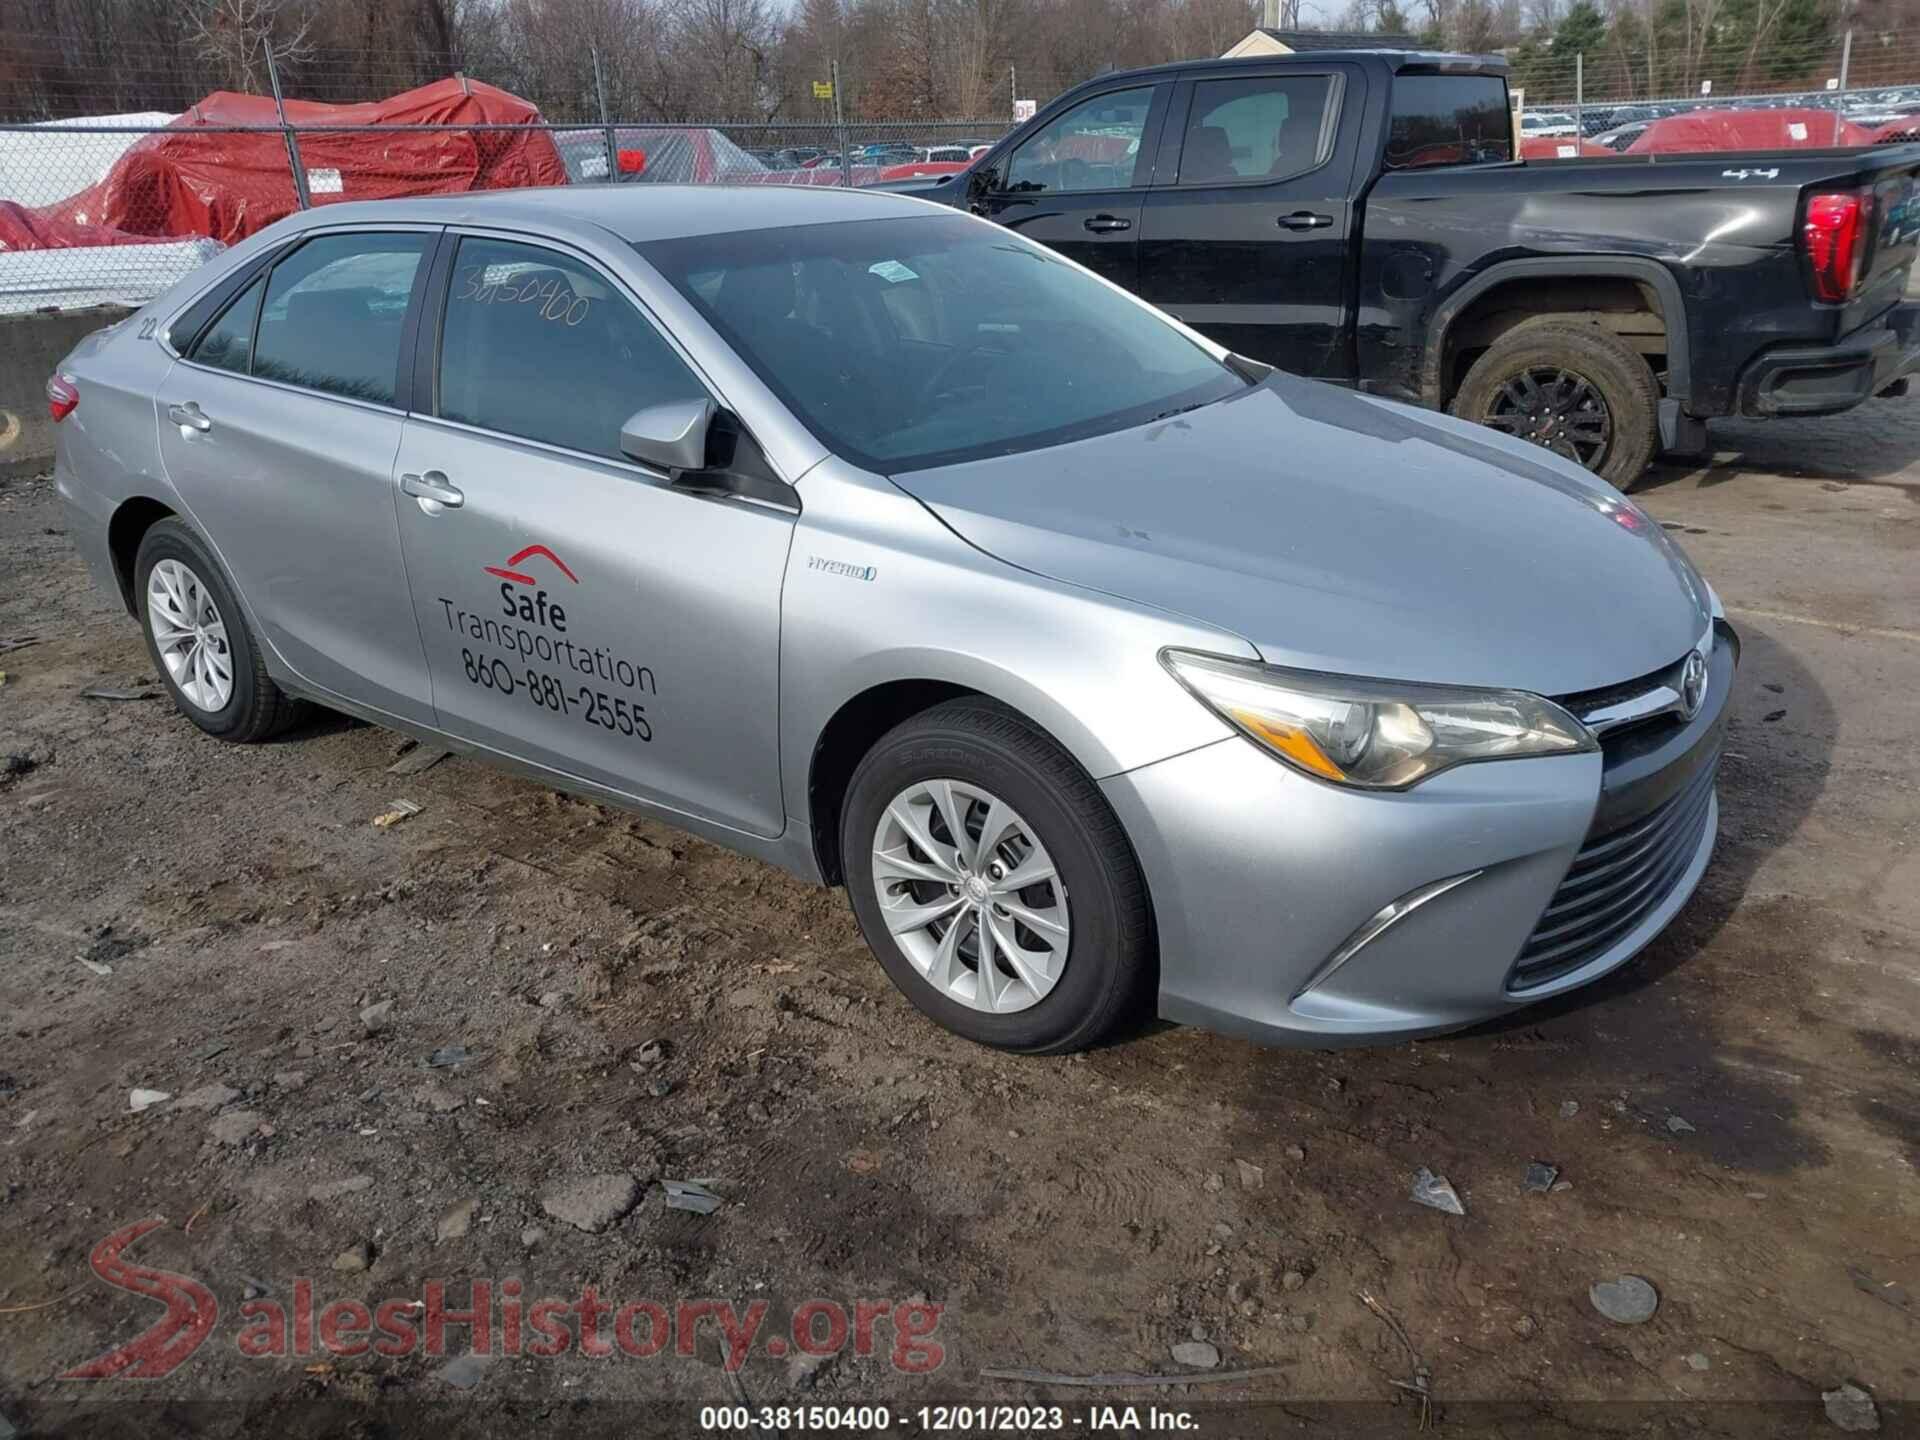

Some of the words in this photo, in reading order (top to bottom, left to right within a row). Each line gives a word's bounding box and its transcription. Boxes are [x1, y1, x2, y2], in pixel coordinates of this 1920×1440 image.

[438, 597, 657, 695] Transportation
[501, 582, 567, 632] Safe
[462, 648, 652, 742] 860-881-2555
